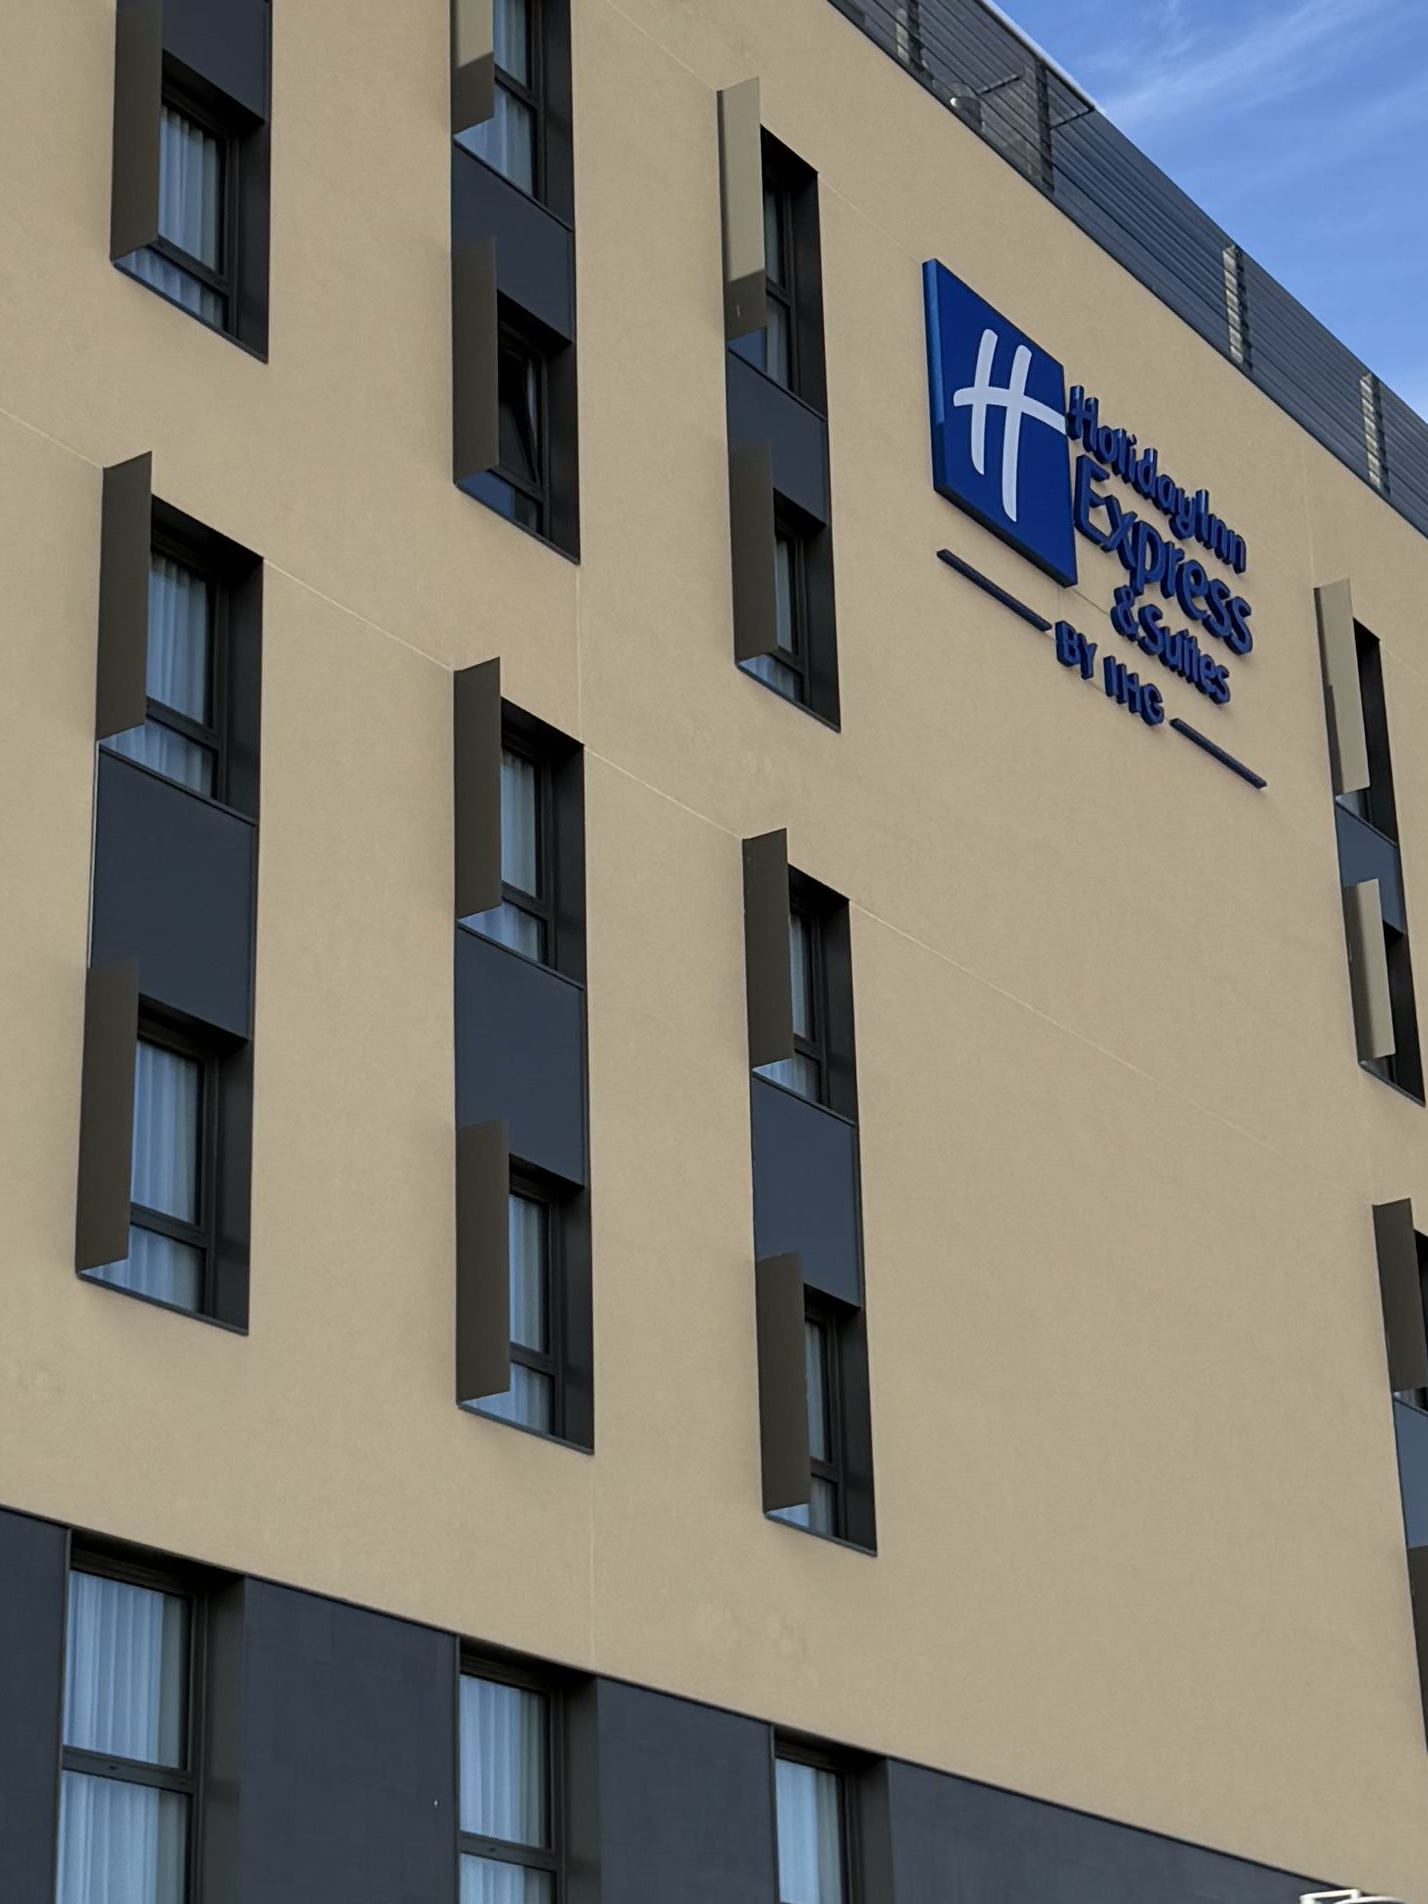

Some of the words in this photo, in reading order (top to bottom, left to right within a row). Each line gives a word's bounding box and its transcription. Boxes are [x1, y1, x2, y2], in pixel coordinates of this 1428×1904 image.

[1074, 454, 1253, 655] Express
[1055, 620, 1098, 680] BY
[1103, 655, 1165, 726] IHG
